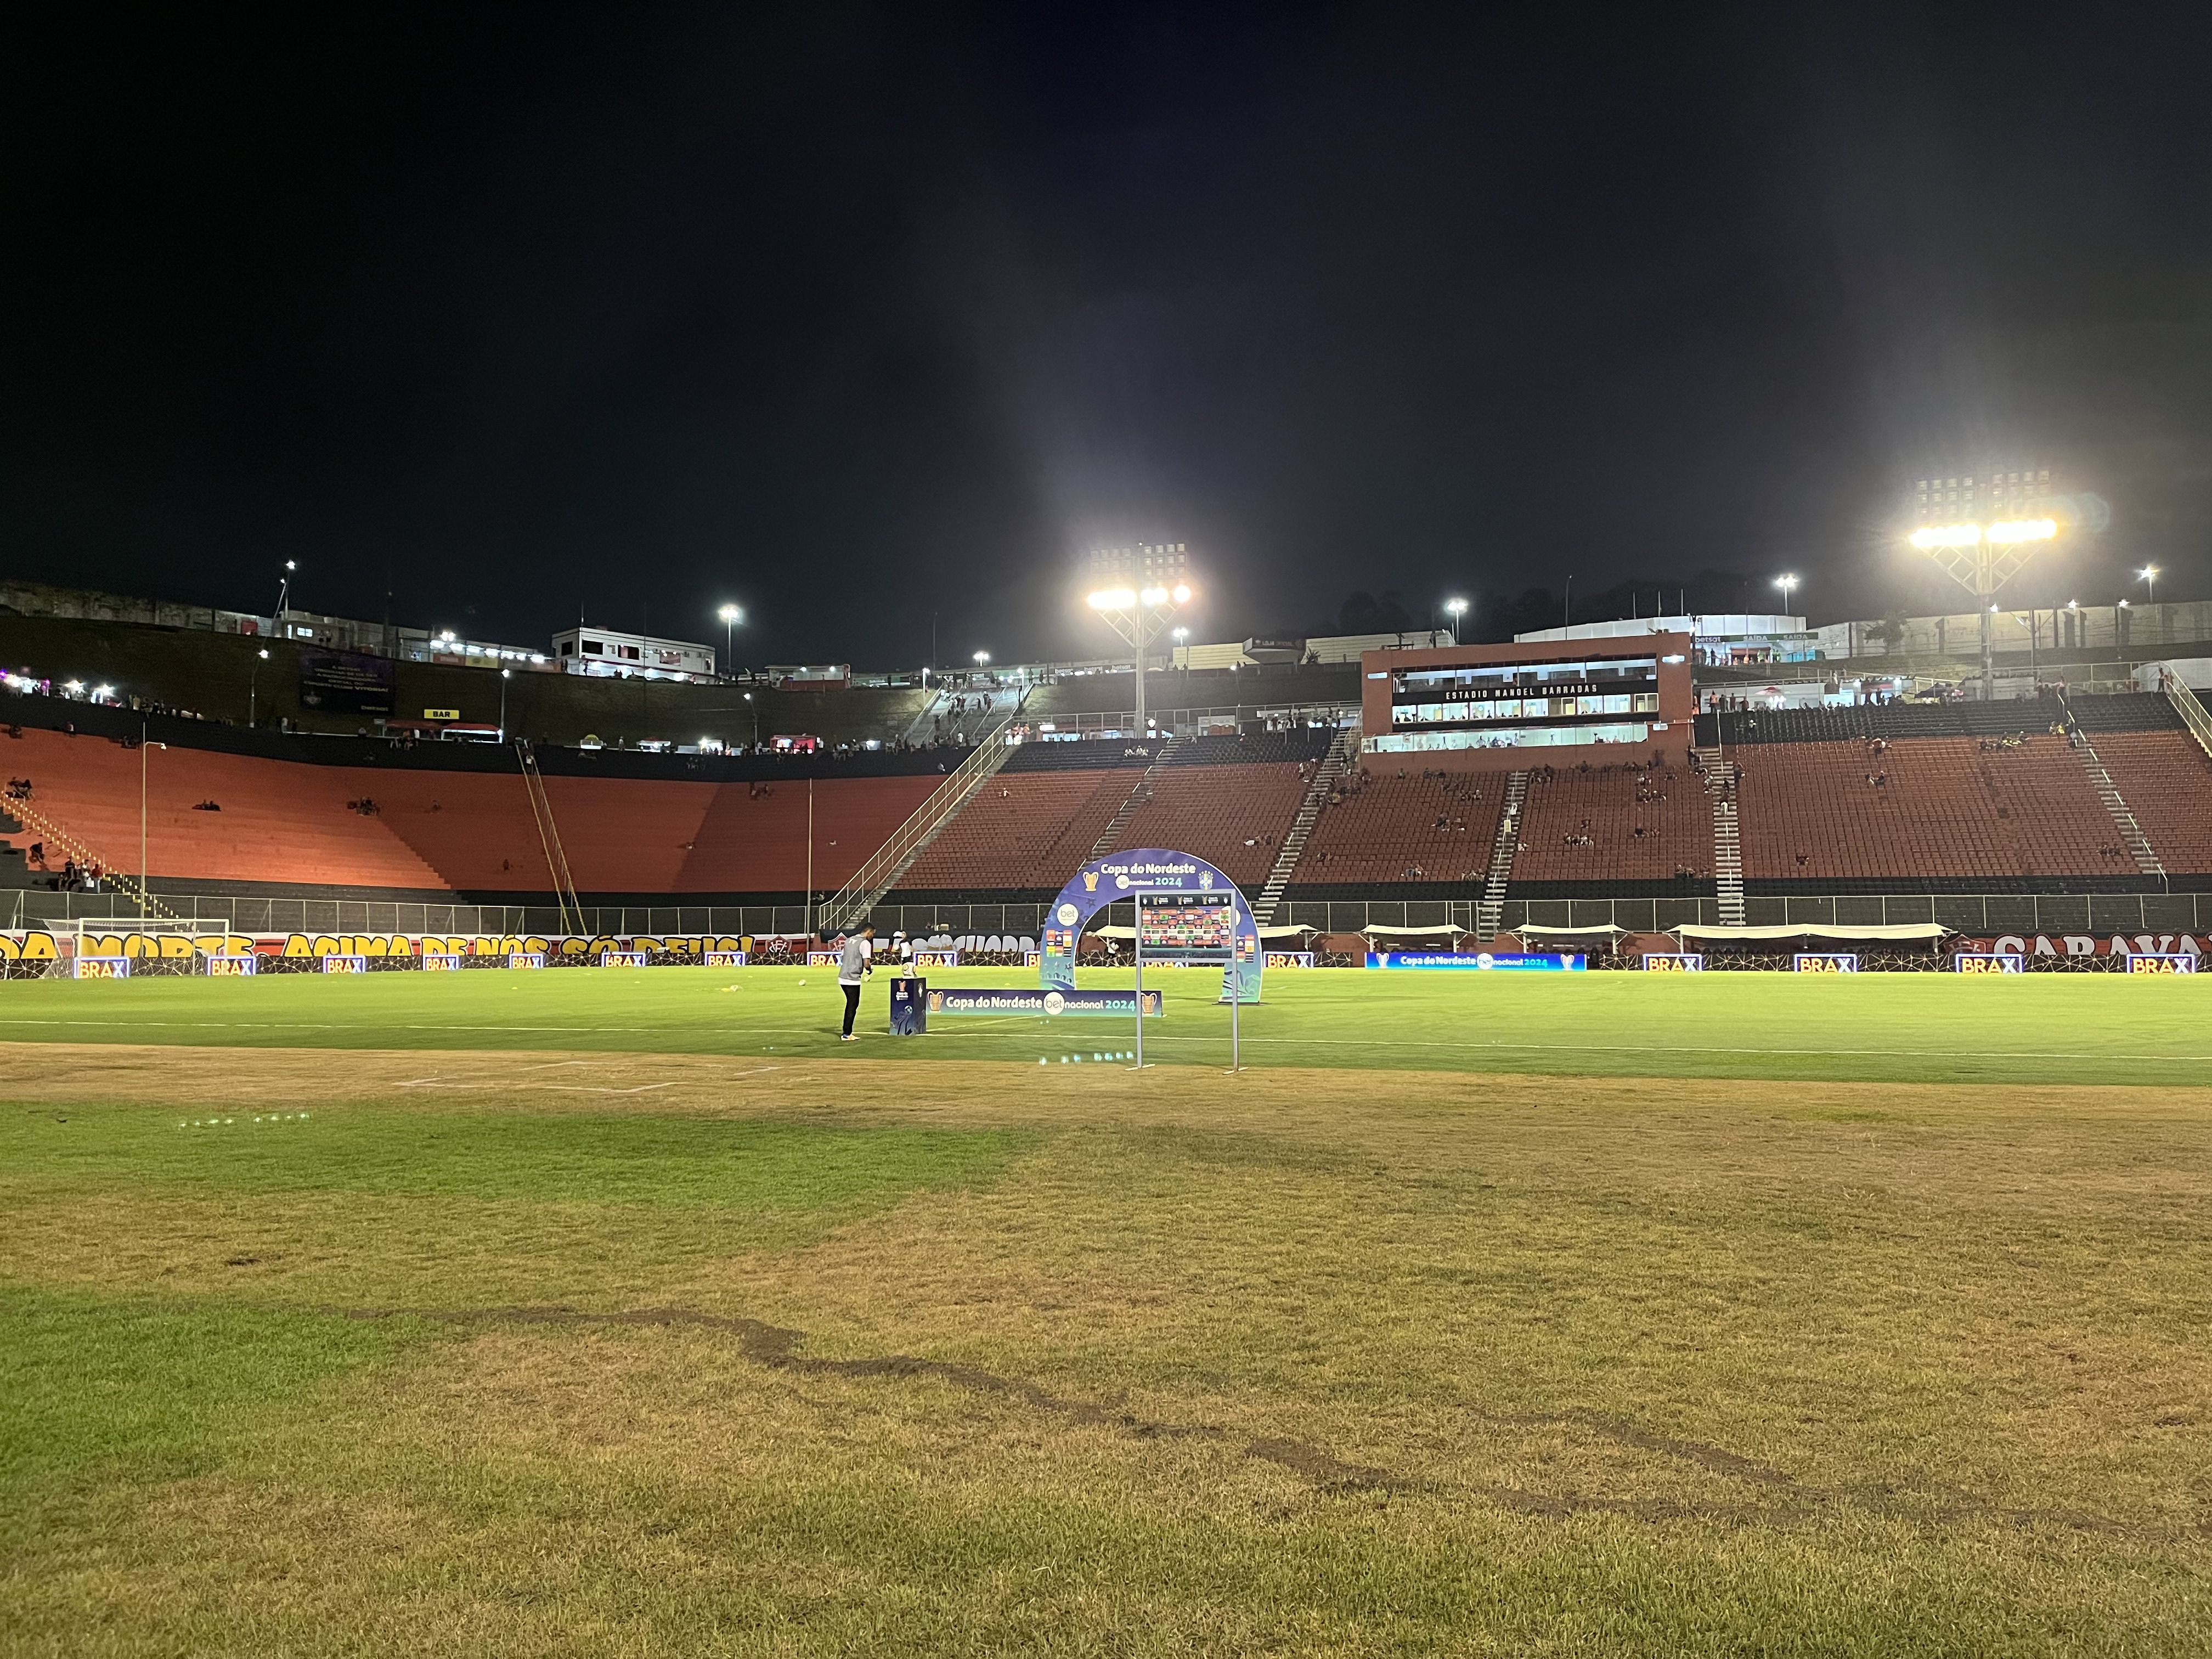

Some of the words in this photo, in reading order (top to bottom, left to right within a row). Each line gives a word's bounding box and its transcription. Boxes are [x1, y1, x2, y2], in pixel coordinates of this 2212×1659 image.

[1495, 687, 1534, 697] MANOEL
[1542, 684, 1598, 695] BARRADAS
[1101, 864, 1128, 877] Copa
[1131, 863, 1144, 874] do
[1146, 863, 1197, 874] Nordeste
[1155, 877, 1182, 888] 2024
[1060, 910, 1075, 918] bet
[329, 960, 361, 973] BRAX
[426, 958, 455, 970] BRAX
[512, 957, 540, 969] BRAX
[606, 956, 641, 967] BRAX
[708, 955, 742, 966] BRAX
[918, 955, 953, 967] BRAX
[1267, 955, 1308, 968] BRAX
[1401, 956, 1423, 967] Copa
[1424, 956, 1435, 965] do
[1436, 956, 1476, 966] Nordeste
[1525, 959, 1548, 967] 2024
[1649, 958, 1696, 972] BRAX
[1801, 958, 1852, 973] BRAX
[1962, 958, 2017, 973] BRAX
[2133, 957, 2189, 973] BRAX
[80, 961, 124, 978] BRAX
[212, 960, 251, 975] BRAX
[946, 996, 974, 1011] Copa
[975, 996, 990, 1008] do
[991, 996, 1042, 1008] Nordeste
[1105, 1000, 1136, 1012] 2024
